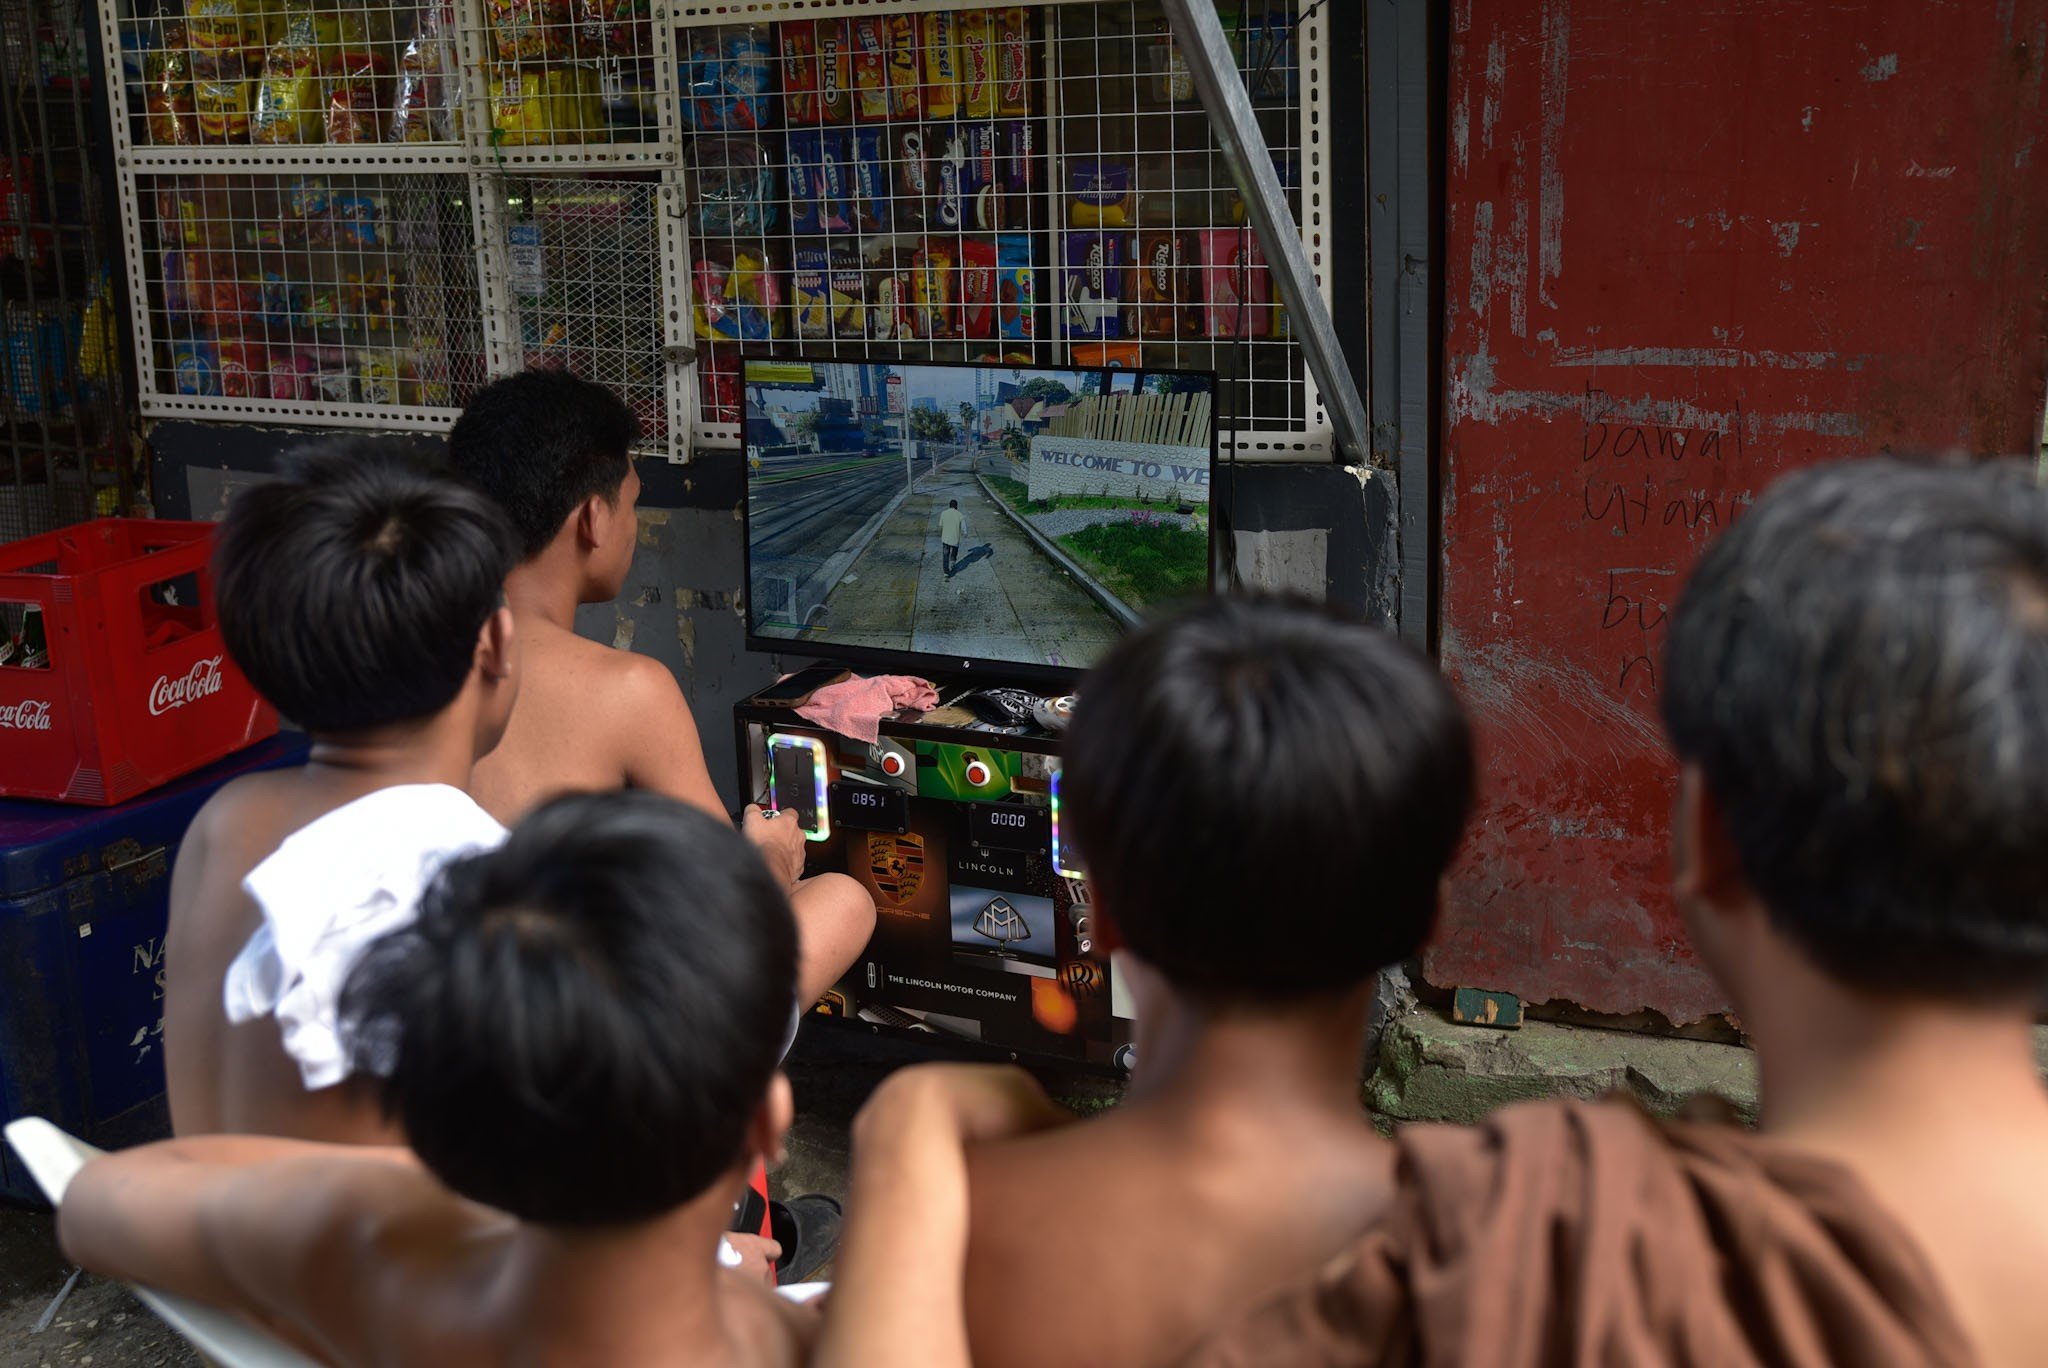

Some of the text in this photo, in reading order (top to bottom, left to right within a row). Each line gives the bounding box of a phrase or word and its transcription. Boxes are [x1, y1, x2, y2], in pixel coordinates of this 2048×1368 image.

[895, 13, 914, 68] FITA
[822, 39, 839, 106] HI-RO
[790, 153, 807, 196] OREO
[824, 153, 839, 195] OREO
[859, 161, 873, 198] OREO
[1089, 243, 1103, 291] Richoco
[1155, 243, 1170, 291] Richoco
[1041, 450, 1123, 473] WELCOME
[1129, 460, 1162, 478] TO
[149, 654, 223, 716] Coca-Cola
[0, 699, 52, 730] ca-Cola
[851, 792, 885, 807] 0851
[991, 812, 1026, 827] 0000
[958, 861, 1014, 876] LINCOLN
[877, 906, 931, 920] ORSCHE
[888, 974, 1017, 1002] THE LINCOLN MOTOR COMPANY
